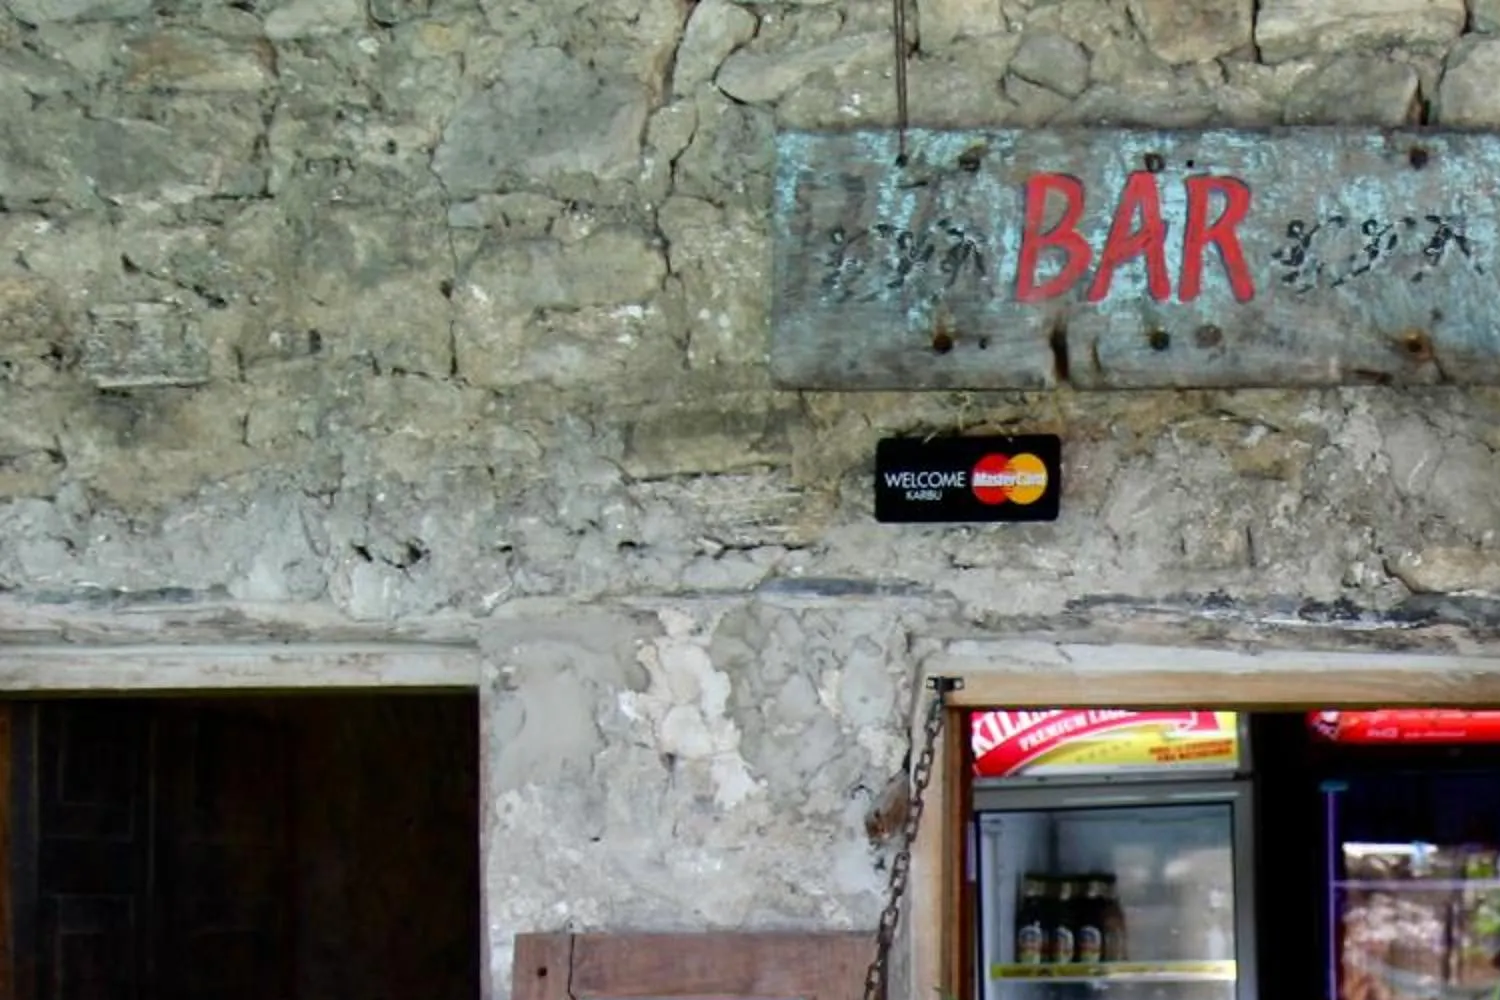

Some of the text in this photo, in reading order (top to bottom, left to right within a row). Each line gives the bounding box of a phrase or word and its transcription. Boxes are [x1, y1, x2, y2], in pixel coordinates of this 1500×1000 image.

[1014, 170, 1256, 305] BAR
[884, 471, 966, 488] WELCOME
[905, 489, 943, 501] KARIBU
[1018, 711, 1088, 752] PREMIUM
